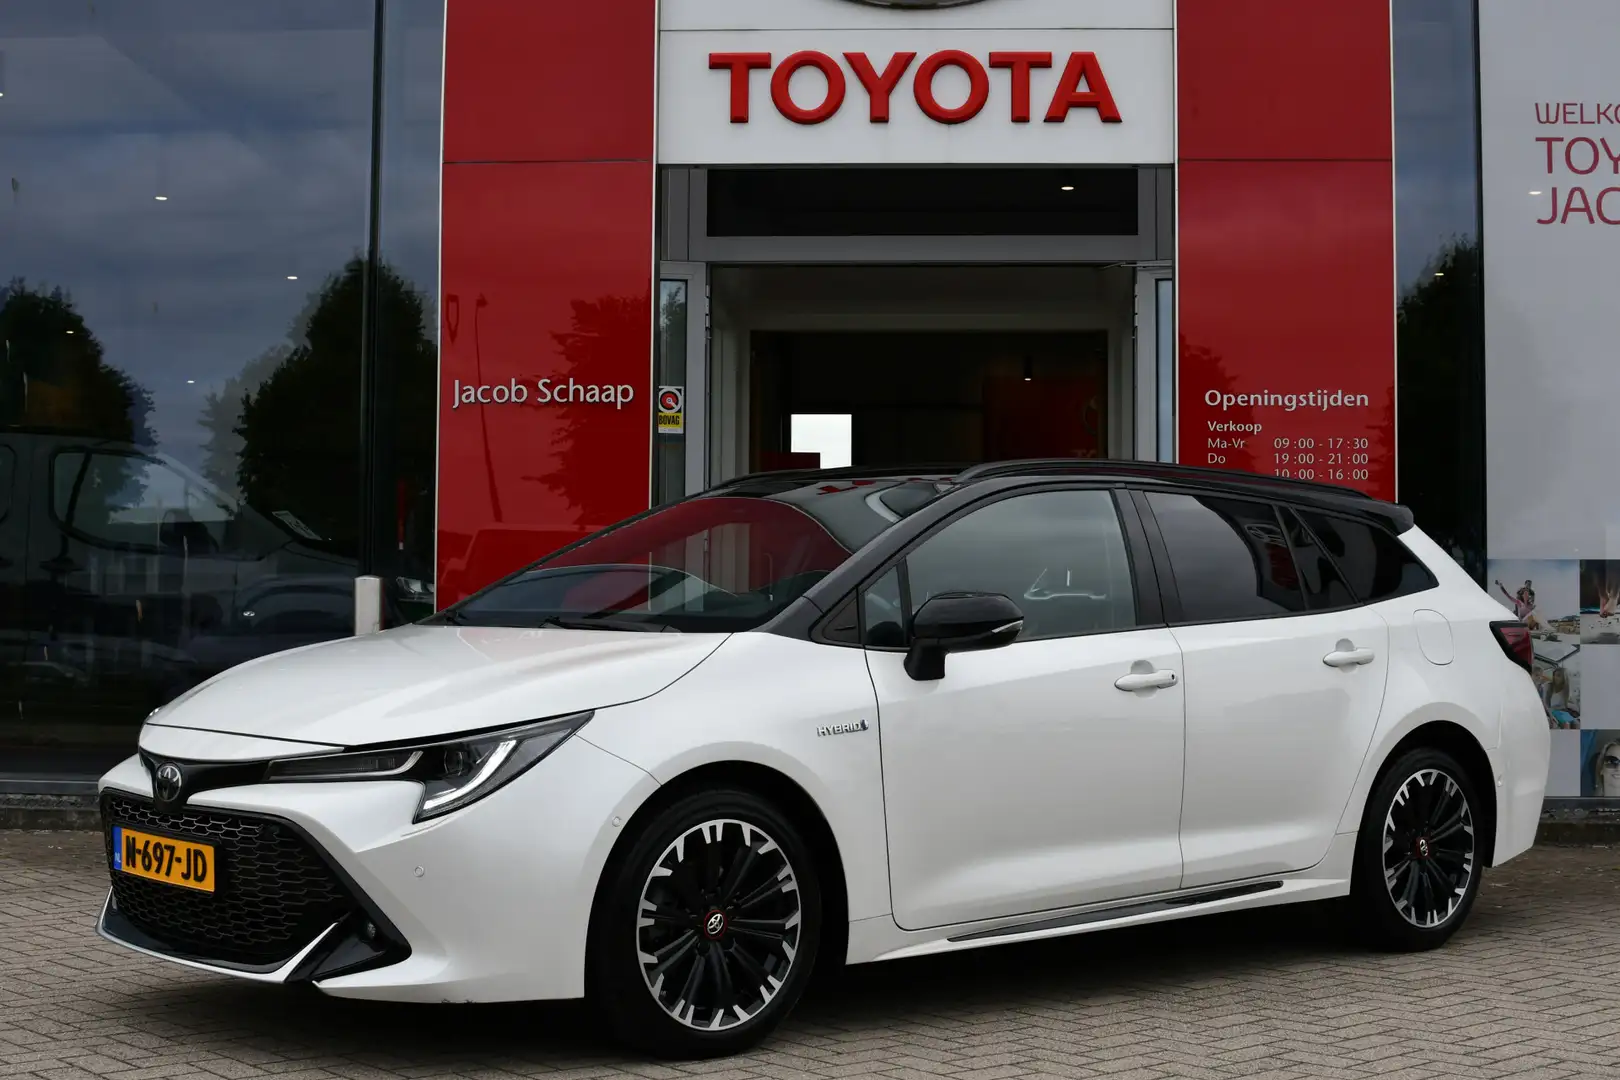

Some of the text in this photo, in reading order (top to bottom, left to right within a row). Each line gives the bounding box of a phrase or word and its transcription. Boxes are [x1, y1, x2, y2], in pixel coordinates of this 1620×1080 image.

[708, 49, 1122, 125] TOYOTA
[1535, 102, 1620, 125] WELK
[1535, 136, 1620, 175] TOY
[1536, 186, 1620, 226] JAC
[452, 377, 634, 410] Jacob Schaap
[1204, 389, 1369, 412] Openingstijden
[658, 414, 680, 426] BOVAG
[1207, 420, 1263, 435] Verkoop
[1207, 437, 1246, 449] Ma-Vr
[1207, 453, 1226, 464] Do
[816, 722, 861, 737] HYBRID
[114, 851, 121, 863] NL
[125, 835, 208, 883] N-697-JD
